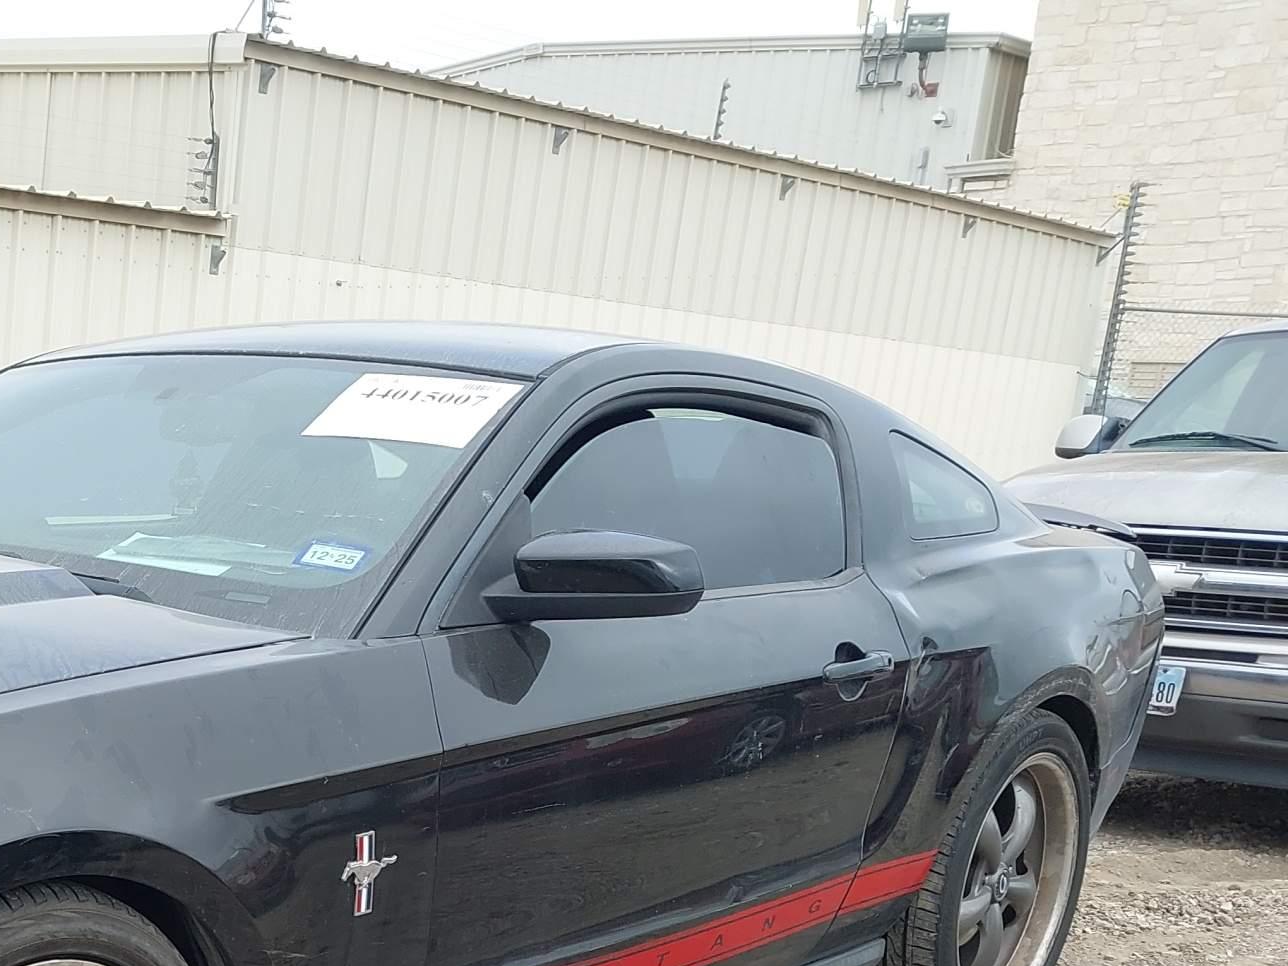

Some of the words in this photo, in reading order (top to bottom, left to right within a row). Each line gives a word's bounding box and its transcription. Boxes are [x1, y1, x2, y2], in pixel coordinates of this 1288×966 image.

[360, 386, 489, 408] 44015007
[310, 550, 329, 561] 12
[334, 553, 358, 565] 25
